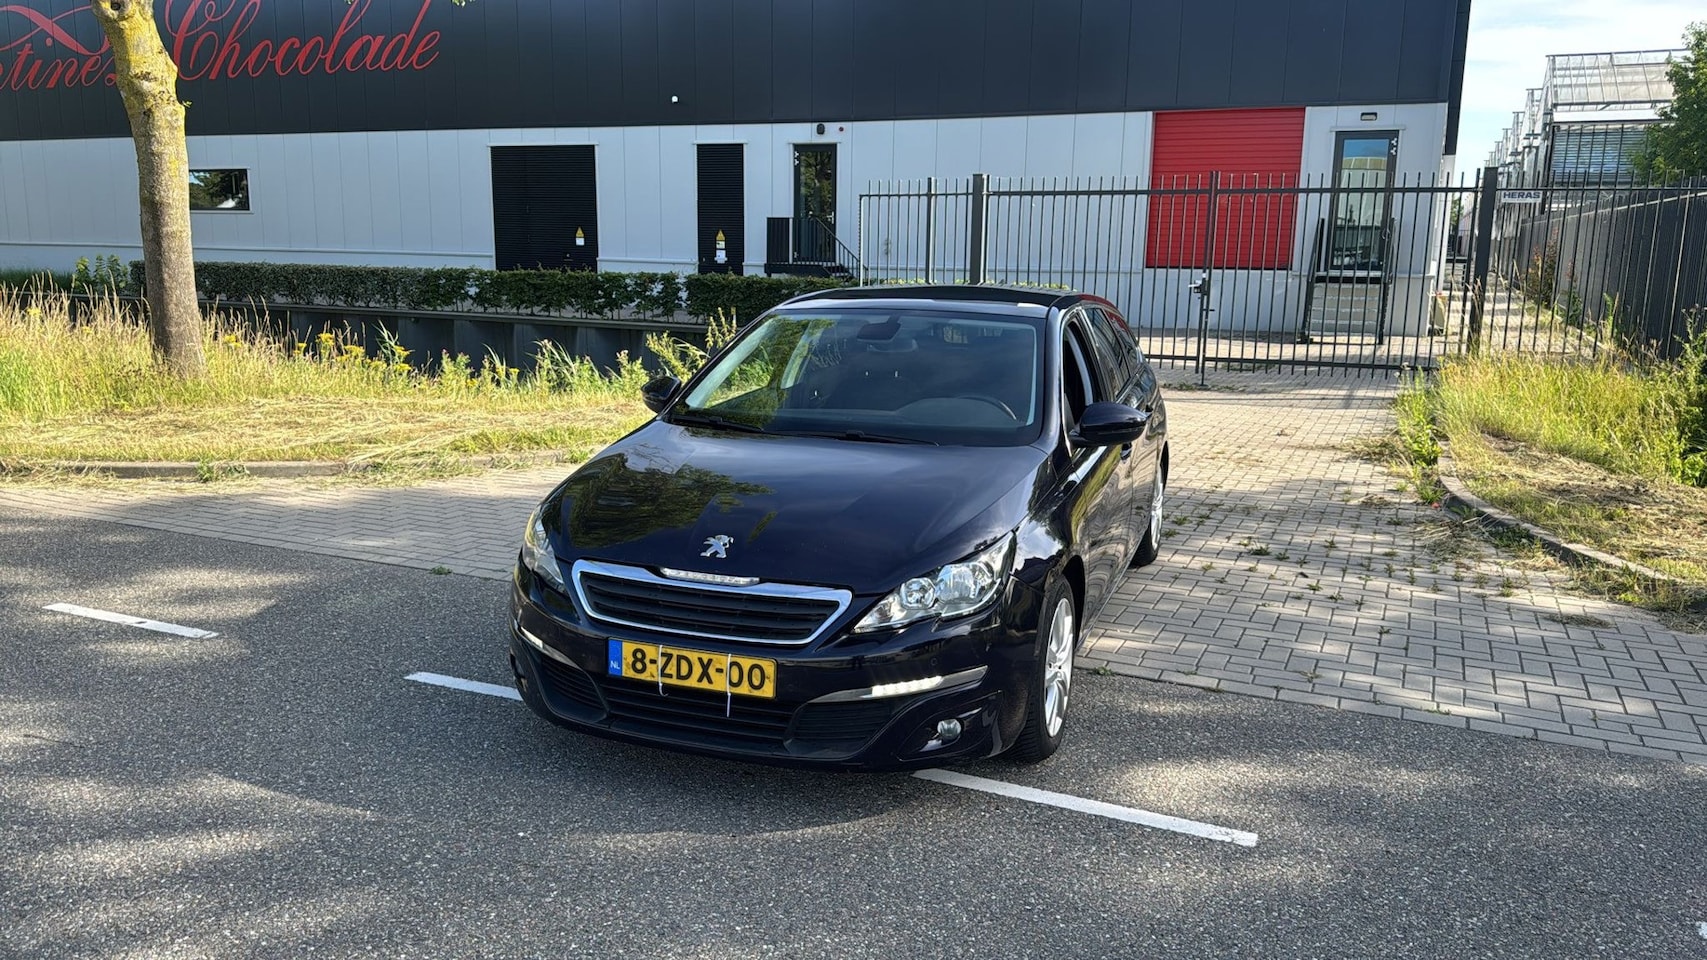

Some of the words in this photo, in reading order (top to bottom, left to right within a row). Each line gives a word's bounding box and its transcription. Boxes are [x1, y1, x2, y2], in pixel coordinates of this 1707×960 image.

[0, 37, 117, 90] tine
[165, 0, 440, 81] Chocolade
[610, 660, 620, 670] NL
[631, 647, 766, 691] 8-ZDX-00
